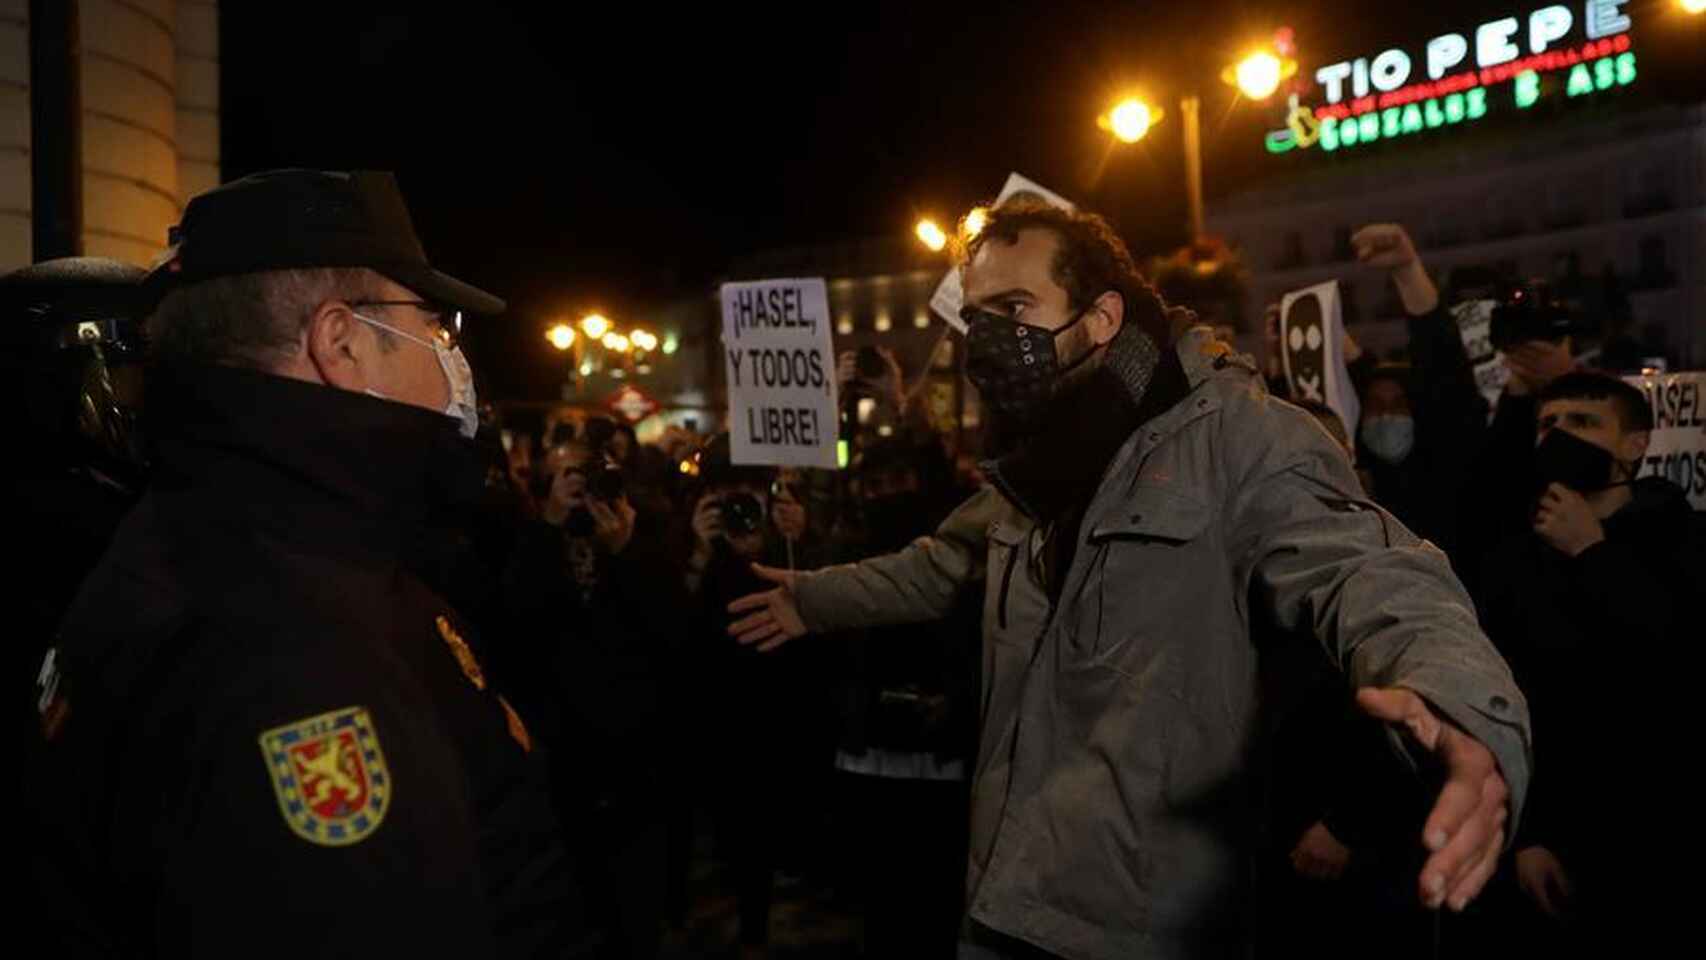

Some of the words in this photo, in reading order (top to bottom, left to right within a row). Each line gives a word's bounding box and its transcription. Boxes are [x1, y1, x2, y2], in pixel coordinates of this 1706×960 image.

[1316, 49, 1412, 104] TIO
[1427, 0, 1632, 79] PEPE
[733, 287, 817, 338] ¡HASEL,
[729, 348, 743, 387] Y
[748, 349, 831, 397] TODOS,
[748, 407, 820, 446] LIBRE!
